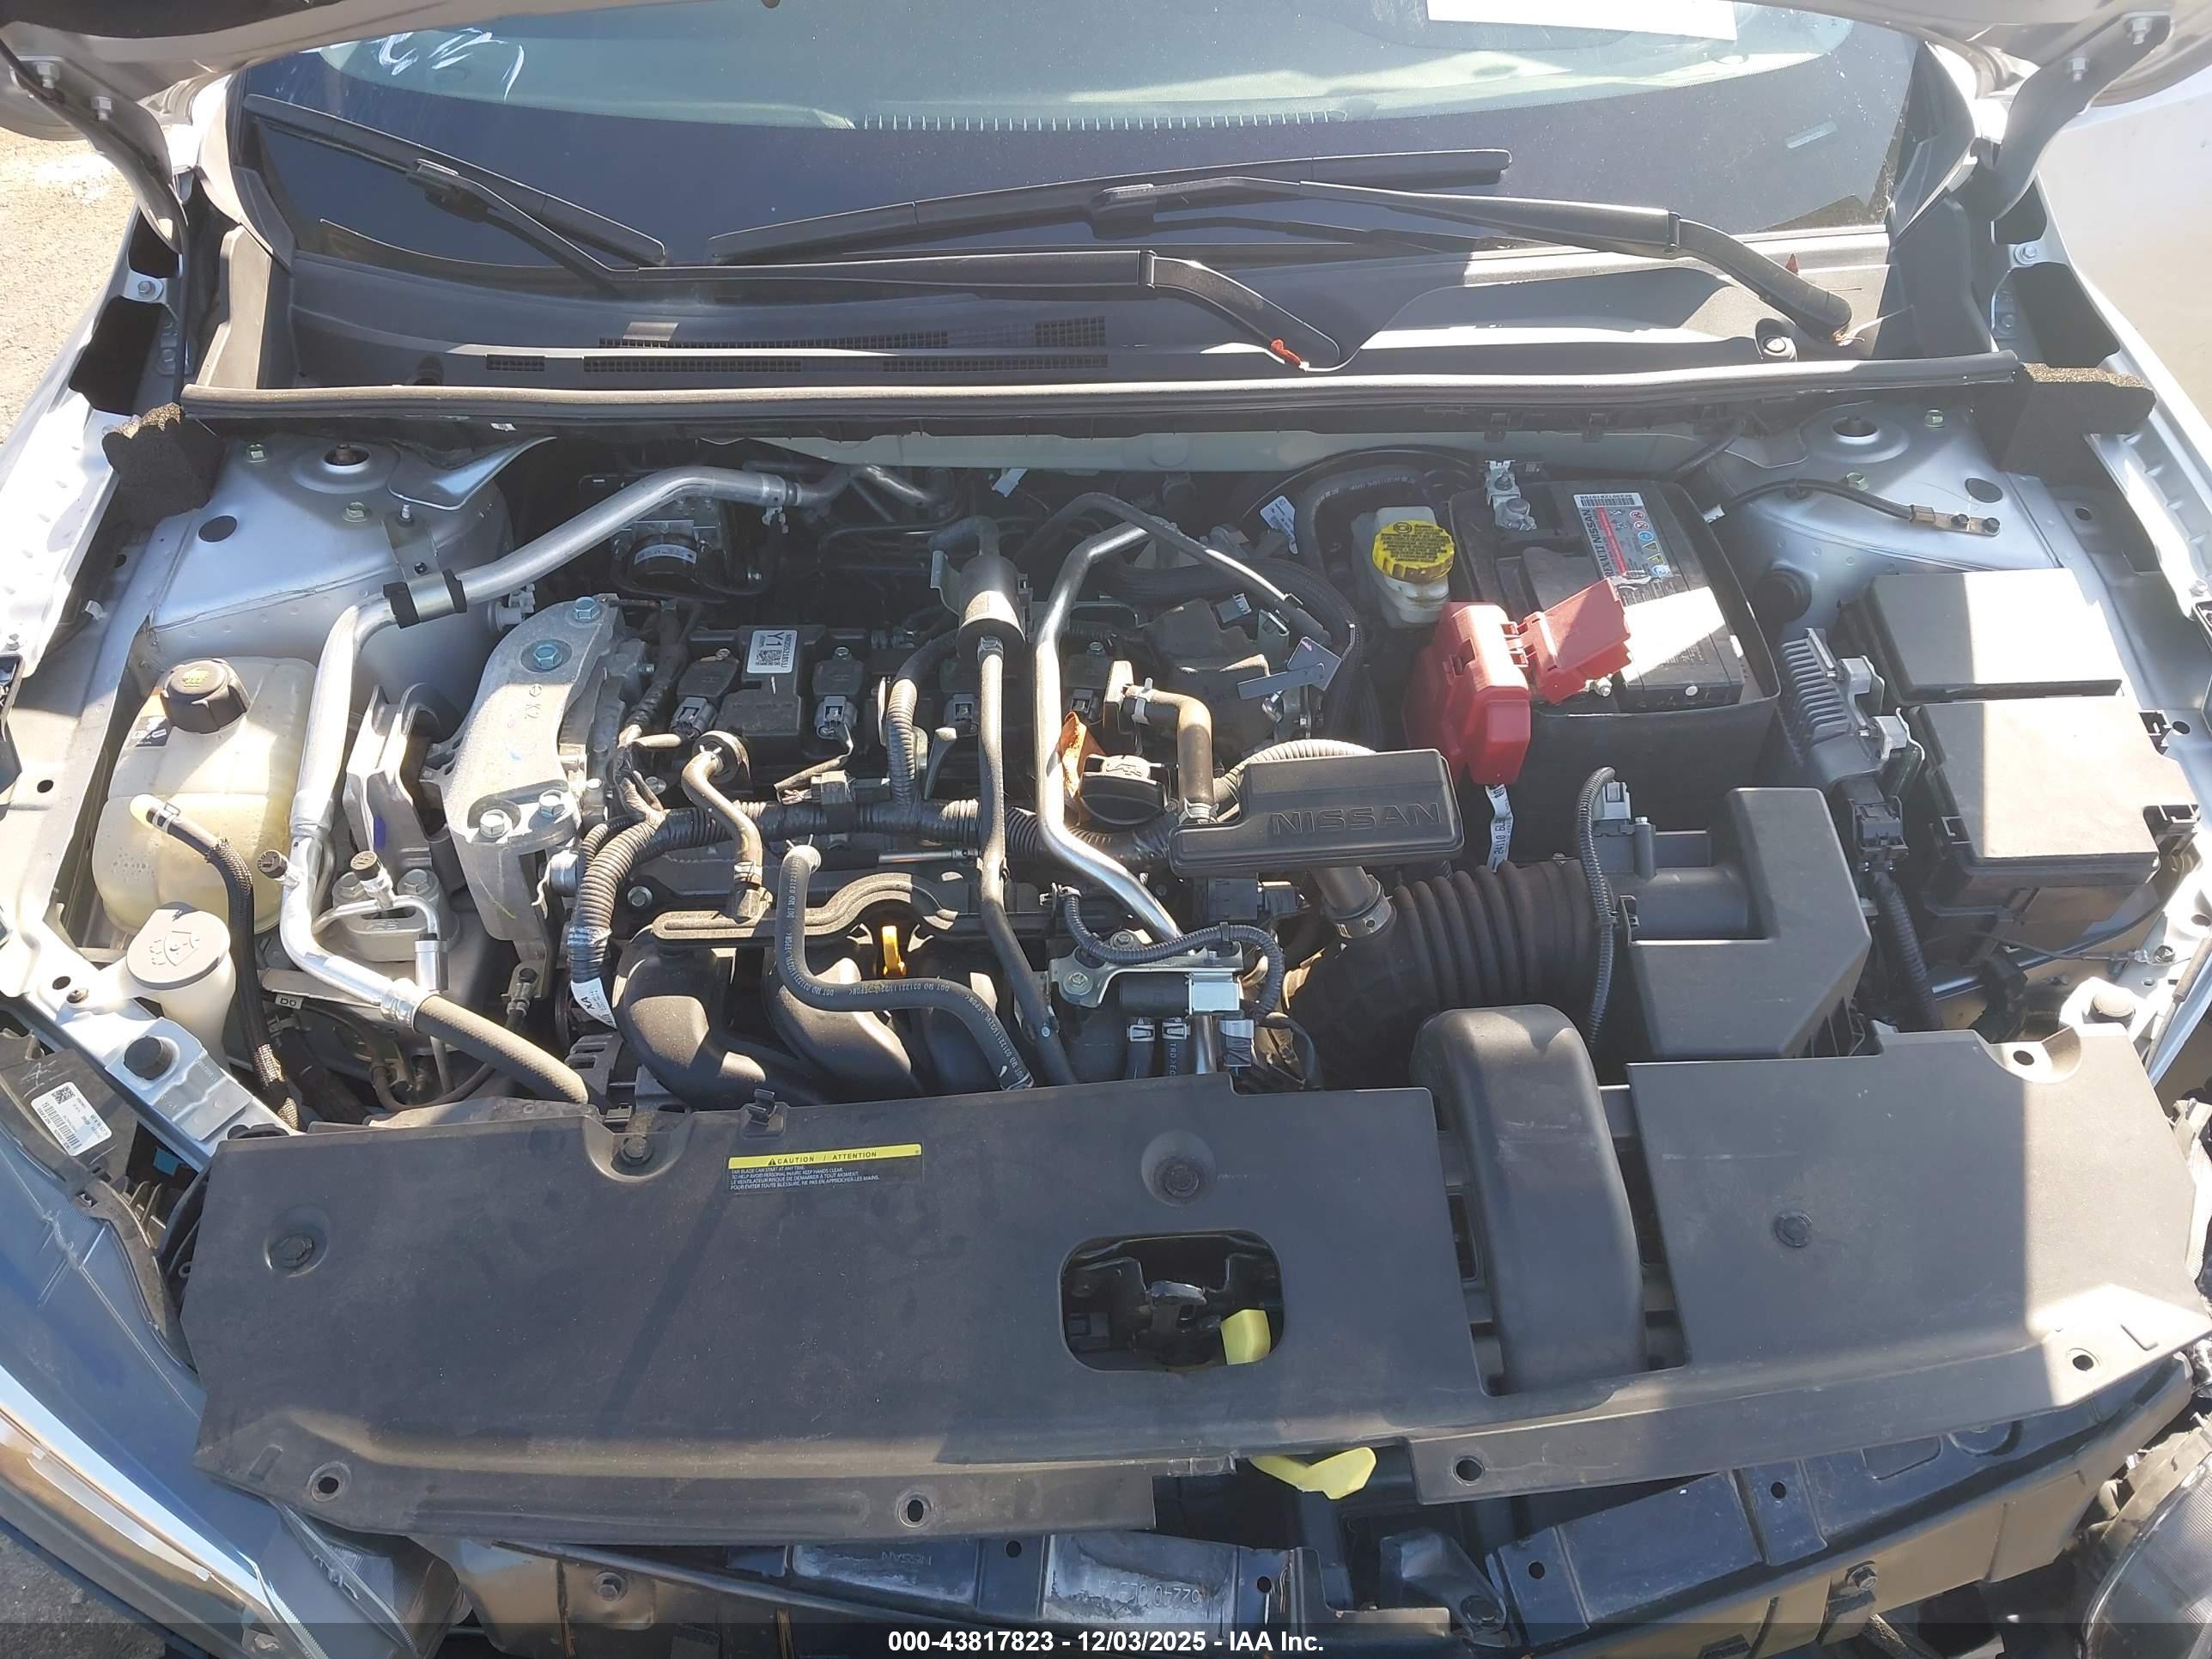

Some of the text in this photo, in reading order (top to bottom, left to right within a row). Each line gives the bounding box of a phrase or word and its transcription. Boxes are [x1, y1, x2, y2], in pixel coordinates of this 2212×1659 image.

[1583, 509, 1601, 543] NISSAN
[765, 632, 785, 646] Y1
[1268, 802, 1442, 835] NISSAN
[832, 1152, 877, 1160] ATTENTION
